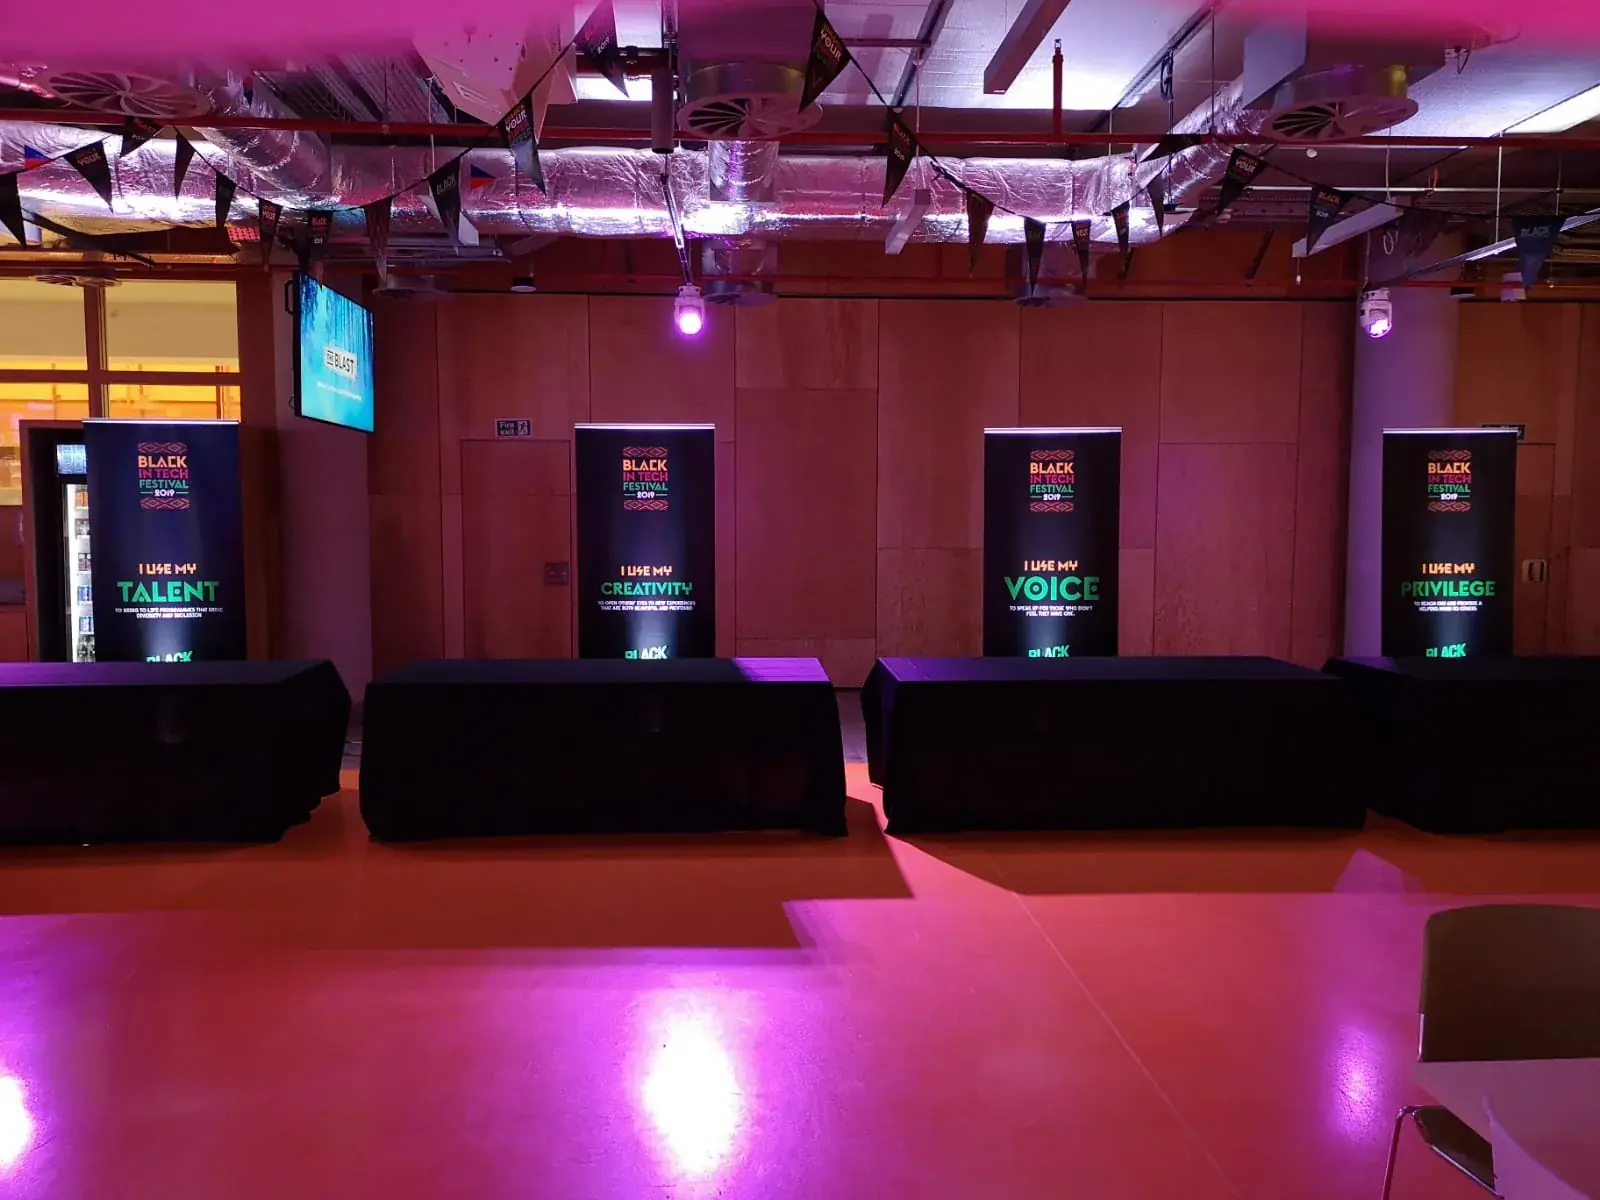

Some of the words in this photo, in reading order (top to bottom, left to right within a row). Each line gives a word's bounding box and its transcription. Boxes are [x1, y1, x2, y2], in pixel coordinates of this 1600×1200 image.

[821, 28, 842, 62] YOUR
[505, 109, 527, 132] YOUR
[1520, 224, 1552, 238] BLACK
[334, 353, 355, 374] BLAST
[138, 455, 188, 468] BLACK
[623, 459, 668, 472] BLACK
[139, 469, 152, 479] IN
[155, 469, 189, 479] TECH
[1030, 462, 1074, 474] BLACK
[1428, 462, 1471, 474] BLACK
[623, 471, 635, 482] IN
[638, 471, 669, 482] TECH
[1030, 474, 1042, 484] IN
[1045, 474, 1075, 484] TECH
[1428, 474, 1440, 484] IN
[1443, 474, 1472, 484] TECH
[140, 479, 189, 489] FESTIVAL
[623, 482, 669, 491] FESTIVAL
[1030, 484, 1074, 493] FESTIVAL
[1428, 484, 1471, 493] FESTIVAL
[154, 489, 175, 497] 2019
[637, 491, 655, 499] 2019
[1042, 493, 1062, 501] 2019
[139, 563, 143, 574] I
[146, 563, 172, 575] USE
[174, 563, 197, 575] MY
[621, 565, 625, 577] I
[627, 565, 651, 577] USE
[652, 565, 673, 577] MY
[1024, 560, 1028, 571] I
[1031, 560, 1055, 572] USE
[1057, 560, 1078, 572] MY
[1422, 563, 1426, 574] I
[1429, 563, 1453, 574] USE
[1454, 563, 1475, 574] MY
[117, 581, 219, 602] TALENT
[601, 582, 693, 596] CREATIVITY
[1004, 576, 1100, 601] VOICE
[1401, 580, 1496, 597] PRIVILEGE
